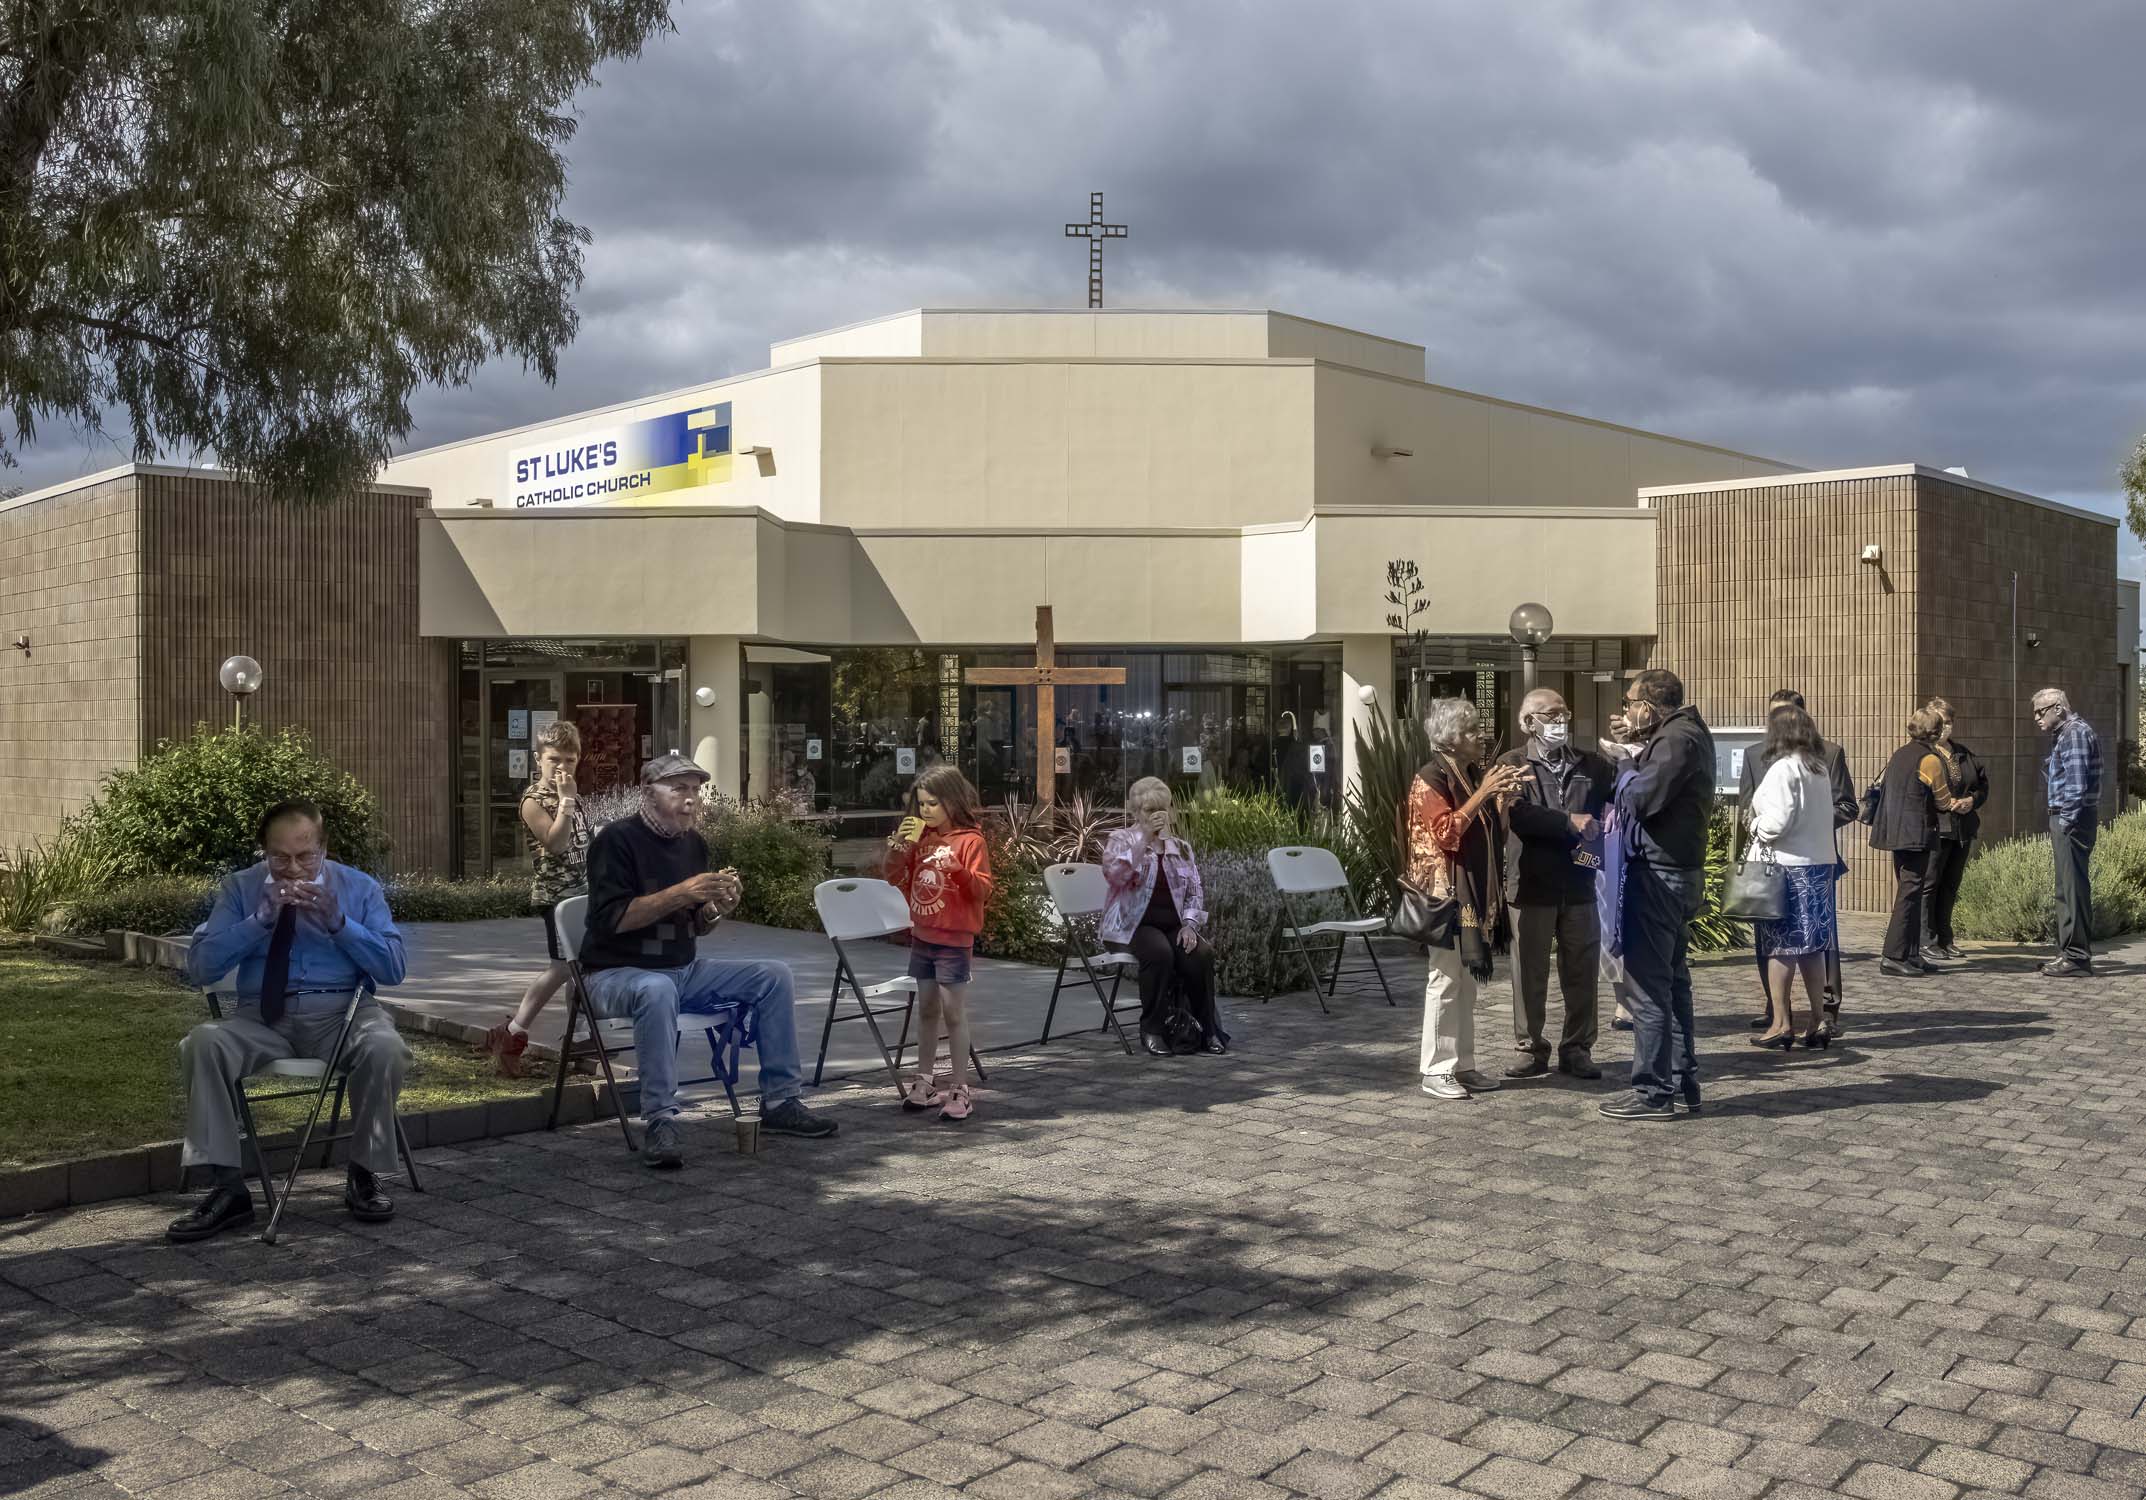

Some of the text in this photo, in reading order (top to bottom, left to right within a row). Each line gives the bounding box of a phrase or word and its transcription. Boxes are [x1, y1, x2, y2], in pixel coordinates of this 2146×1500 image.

[516, 440, 618, 483] ST LUKE'S
[516, 471, 651, 508] CATHOLIC CHURCH
